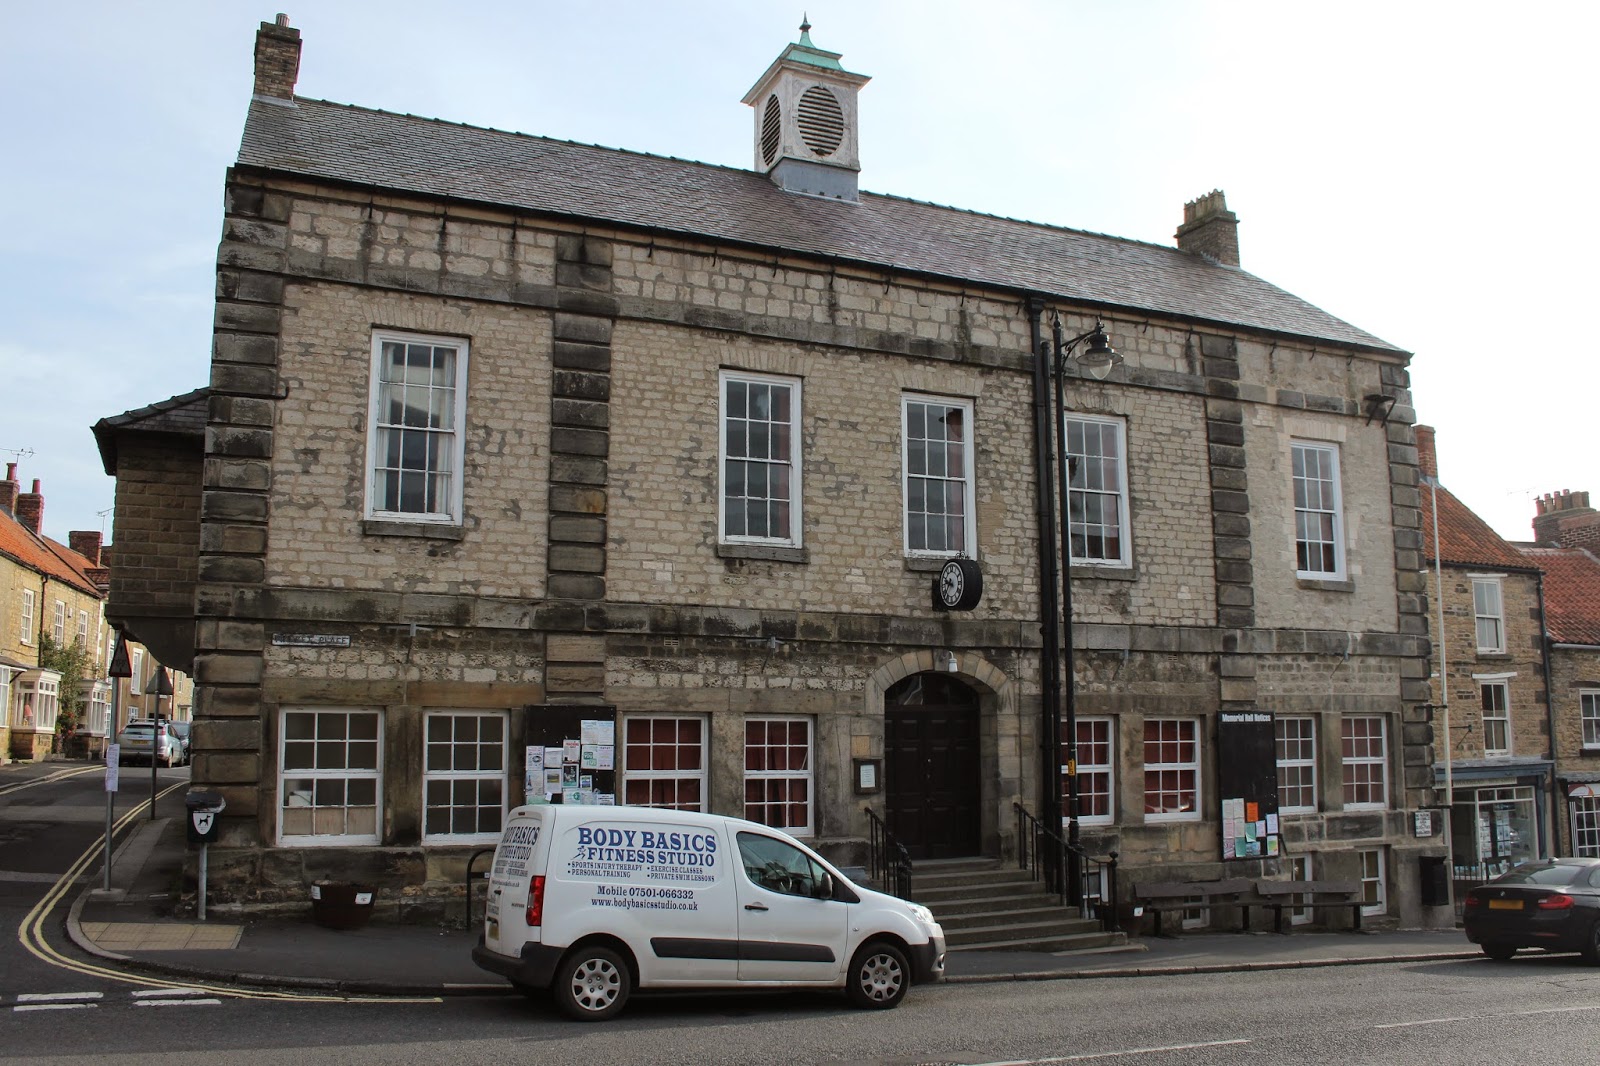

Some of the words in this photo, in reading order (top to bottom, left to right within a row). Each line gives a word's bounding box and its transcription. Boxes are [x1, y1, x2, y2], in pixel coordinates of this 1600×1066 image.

[578, 828, 637, 847] BODY
[641, 831, 717, 853] BASICS
[587, 847, 655, 864] FITNESS
[658, 851, 715, 867] STUDIO
[571, 861, 594, 869] SPORTS
[594, 862, 616, 870] INJURY
[616, 863, 643, 871] THERAPY
[571, 868, 602, 877] PERSONAL
[602, 870, 631, 878] TRAINING
[651, 872, 675, 880] PRIVATE
[675, 873, 691, 881] SWIM
[597, 885, 627, 896] Mobile
[629, 887, 694, 899] 07501-066332
[591, 897, 698, 911] www.bodybasicsstudio.co.uk
